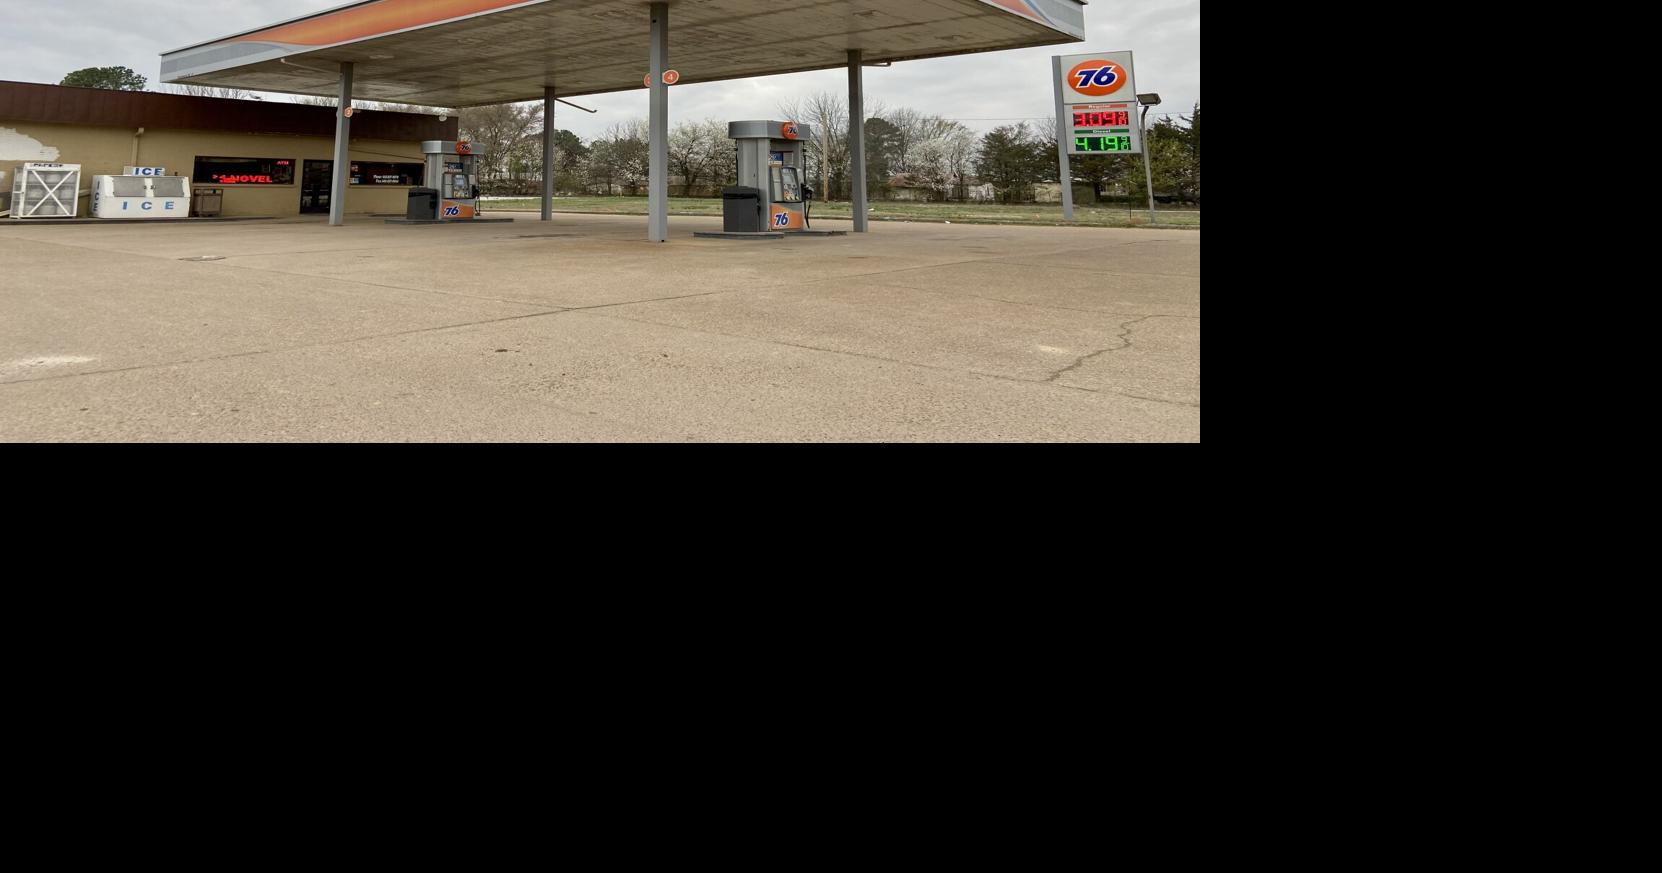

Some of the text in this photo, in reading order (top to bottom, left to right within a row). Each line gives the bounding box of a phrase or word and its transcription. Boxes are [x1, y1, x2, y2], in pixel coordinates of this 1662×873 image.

[1074, 66, 1118, 88] 76
[787, 126, 798, 134] 76
[1075, 136, 1118, 150] 4.19
[134, 167, 163, 175] ICE
[92, 180, 100, 212] ICE
[122, 201, 175, 210] ICE
[444, 205, 460, 217] 76
[774, 212, 789, 227] 76
